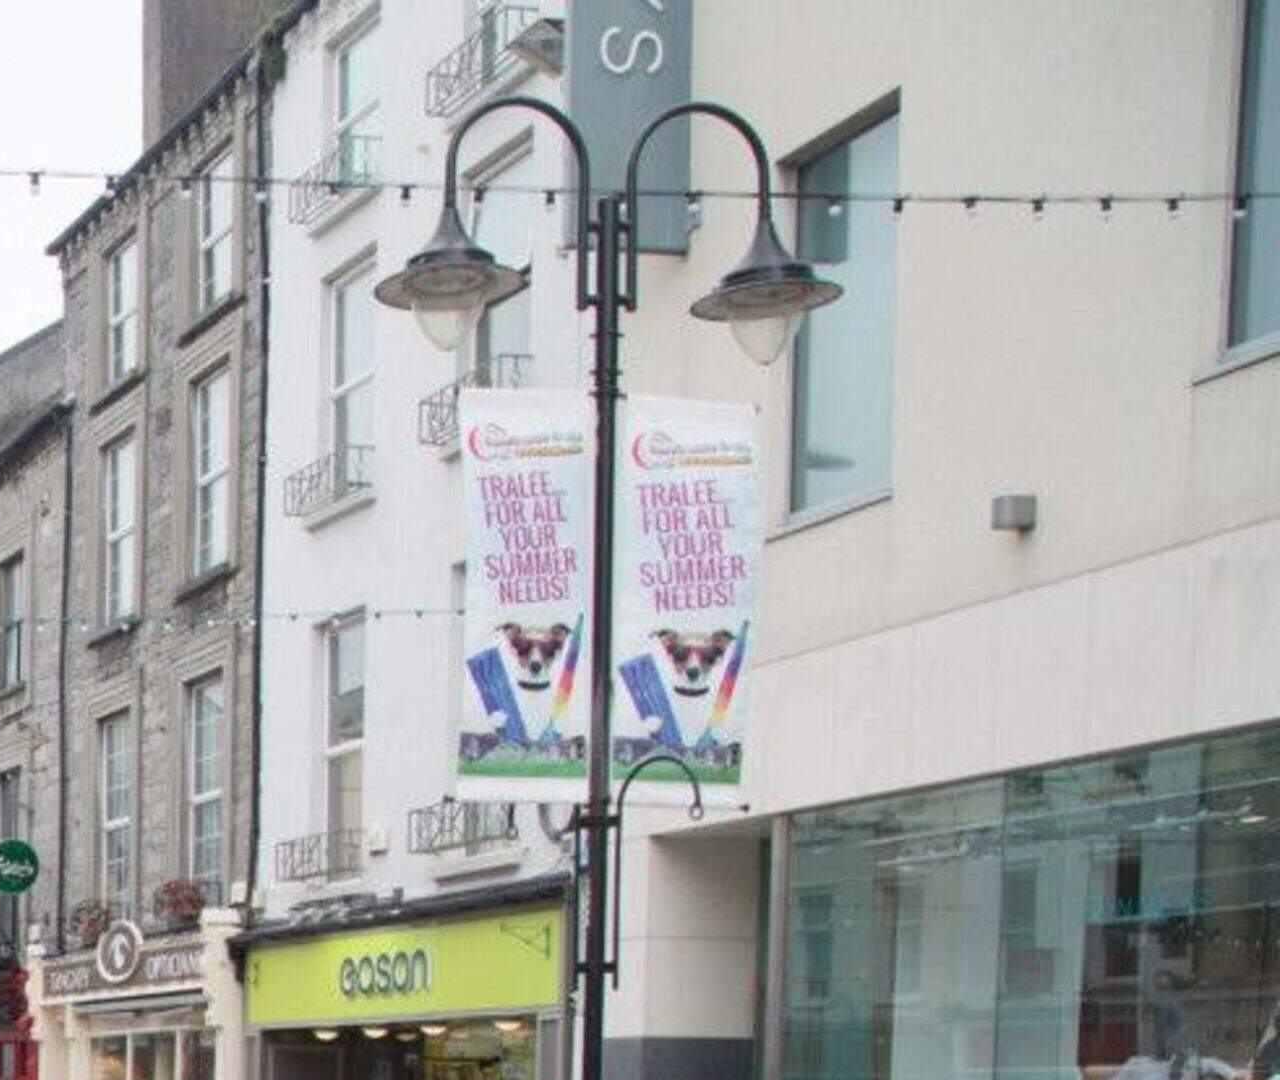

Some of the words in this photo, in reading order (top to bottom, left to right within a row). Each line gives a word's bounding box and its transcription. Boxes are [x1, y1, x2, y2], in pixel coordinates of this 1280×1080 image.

[484, 503, 527, 528] FOR
[532, 496, 567, 523] ALL
[642, 509, 687, 535] FOR
[696, 504, 735, 530] ALL
[500, 525, 557, 550] YOUR
[658, 532, 724, 559] YOUR
[484, 549, 577, 581] SUMMER
[639, 555, 748, 588] SUMMER
[498, 576, 569, 606] NEEDS!
[654, 583, 735, 614] NEEDS!
[340, 949, 429, 998] eason
